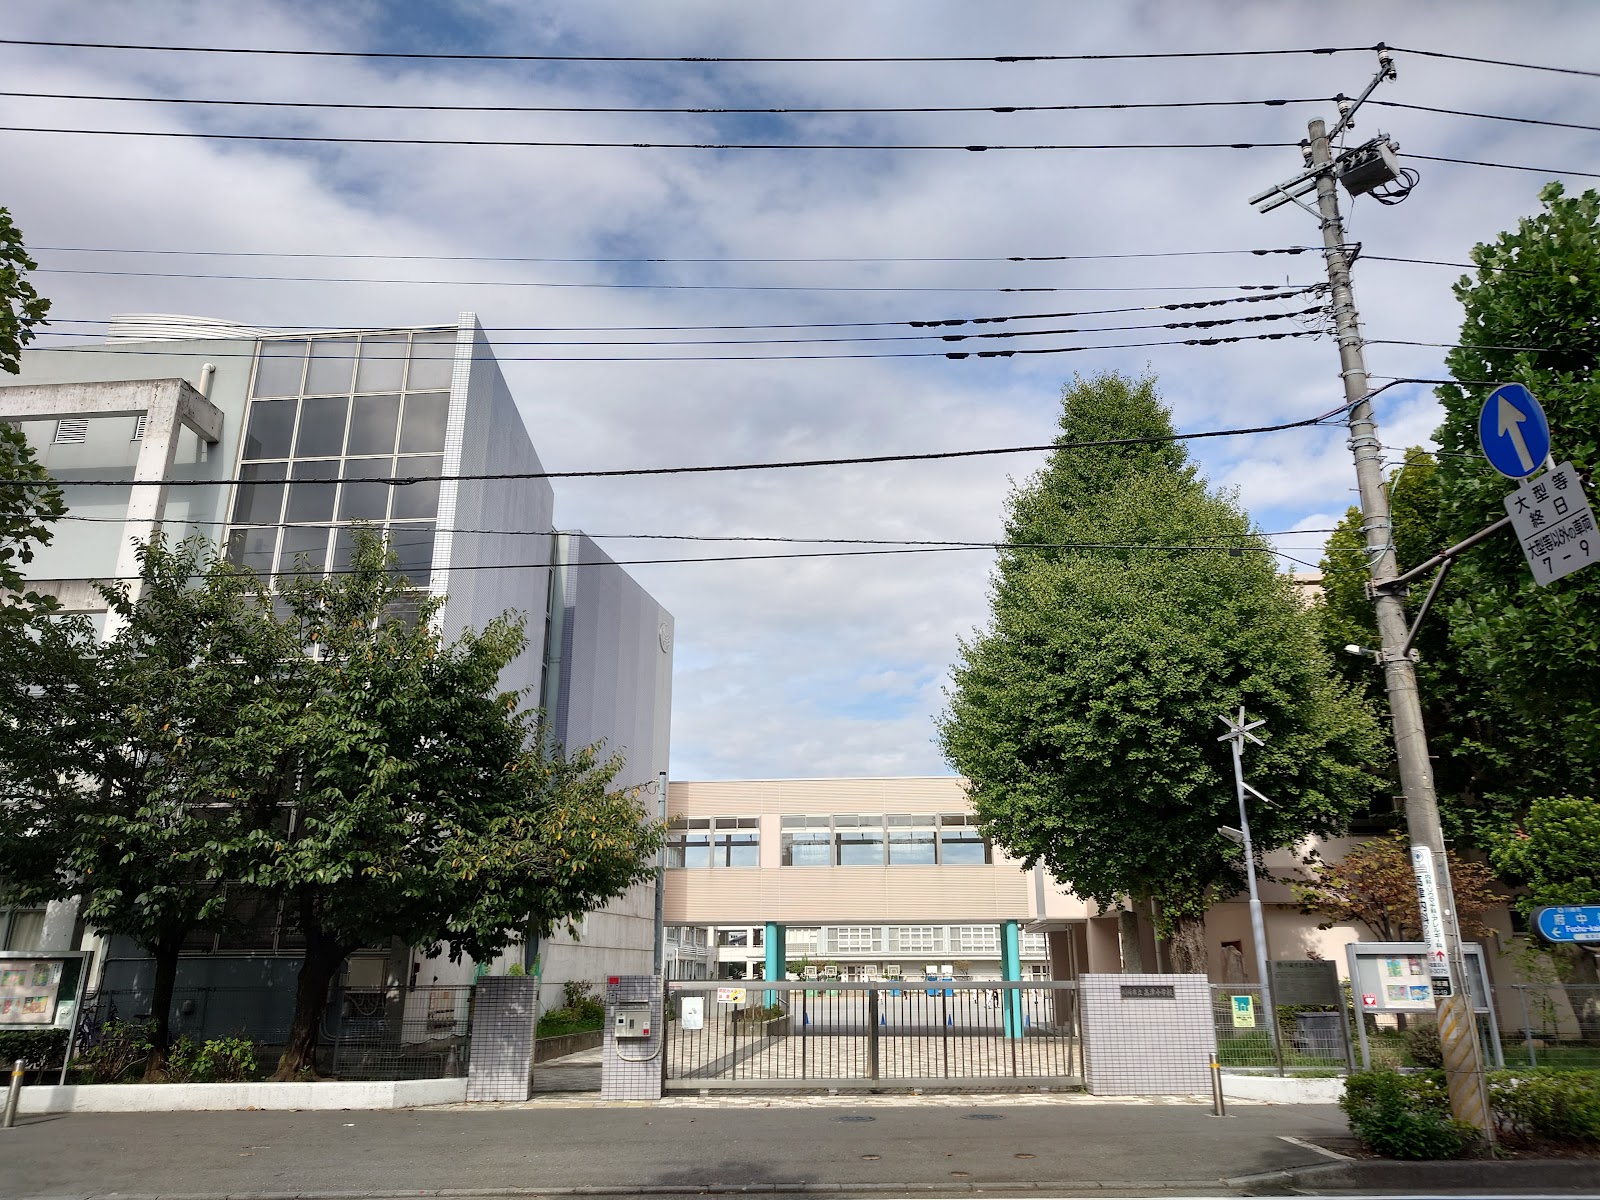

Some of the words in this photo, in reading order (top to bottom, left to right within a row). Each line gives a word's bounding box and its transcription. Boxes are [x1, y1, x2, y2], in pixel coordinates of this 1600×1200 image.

[1514, 471, 1568, 514] 大型等
[1529, 496, 1569, 528] 終日
[1527, 514, 1593, 560] 大型等以外の車両
[1554, 912, 1600, 926] 府中
